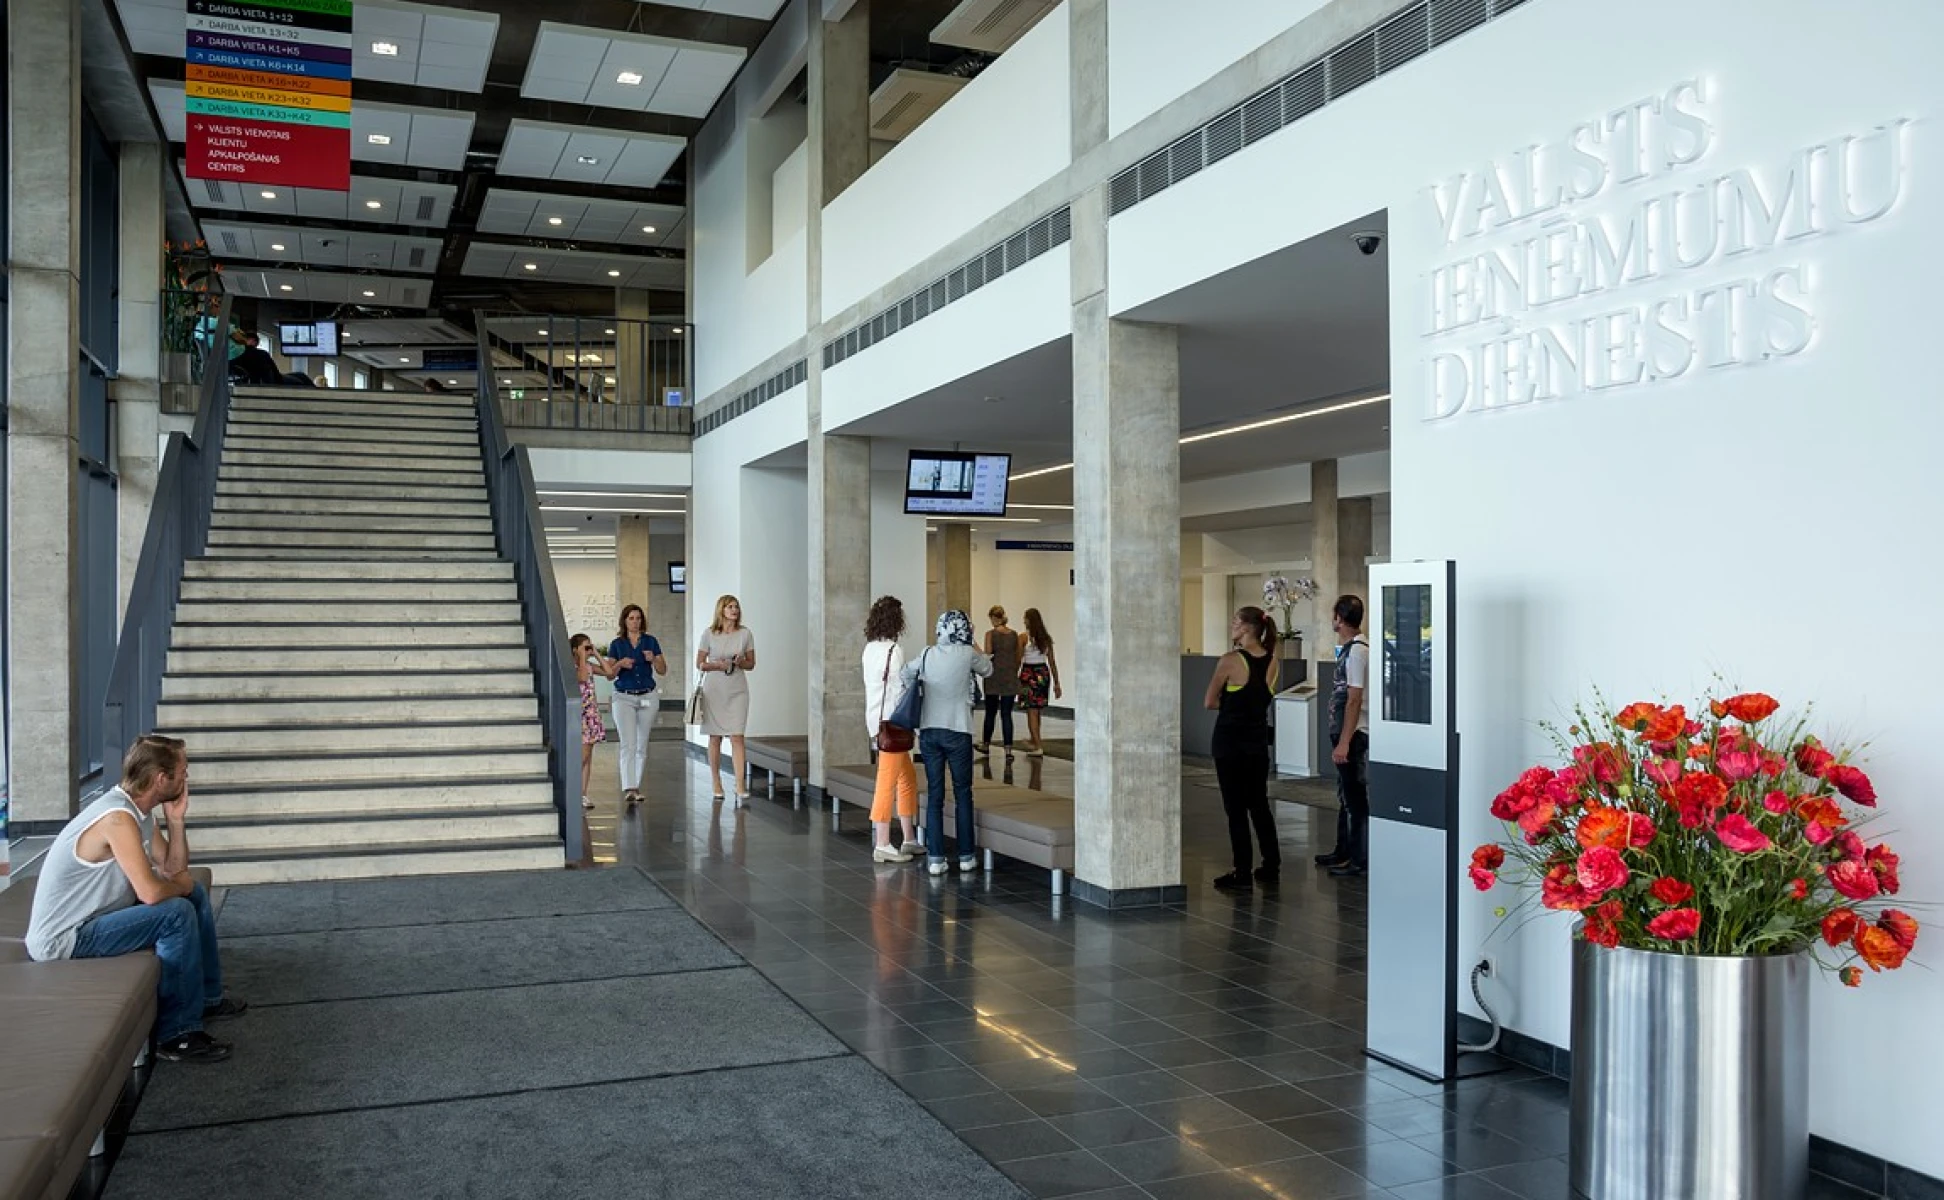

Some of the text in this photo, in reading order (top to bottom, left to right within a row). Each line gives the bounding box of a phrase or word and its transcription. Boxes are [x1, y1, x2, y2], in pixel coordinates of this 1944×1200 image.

[209, 4, 241, 16] DARBA
[242, 8, 268, 19] VIETA
[209, 20, 241, 32] DARBA
[242, 24, 268, 35] VIETA
[208, 36, 240, 48] DARBA
[241, 40, 267, 51] VIETA
[208, 53, 240, 65] DARBA
[241, 56, 266, 67] VIETA
[208, 70, 239, 81] DARBA
[241, 73, 266, 84] VIETA
[208, 86, 239, 98] DARBA
[241, 90, 266, 101] VIETA
[208, 102, 239, 114] DARBA
[241, 106, 266, 117] VIETA
[208, 124, 290, 141] VALSTS VIENOTAIS
[207, 136, 248, 148] KLIENTU
[207, 149, 280, 164] APKALPOŠANAS
[1420, 75, 1717, 246] VALSTS
[207, 161, 246, 173] CENTRS
[1420, 264, 1819, 424] DIENESTS
